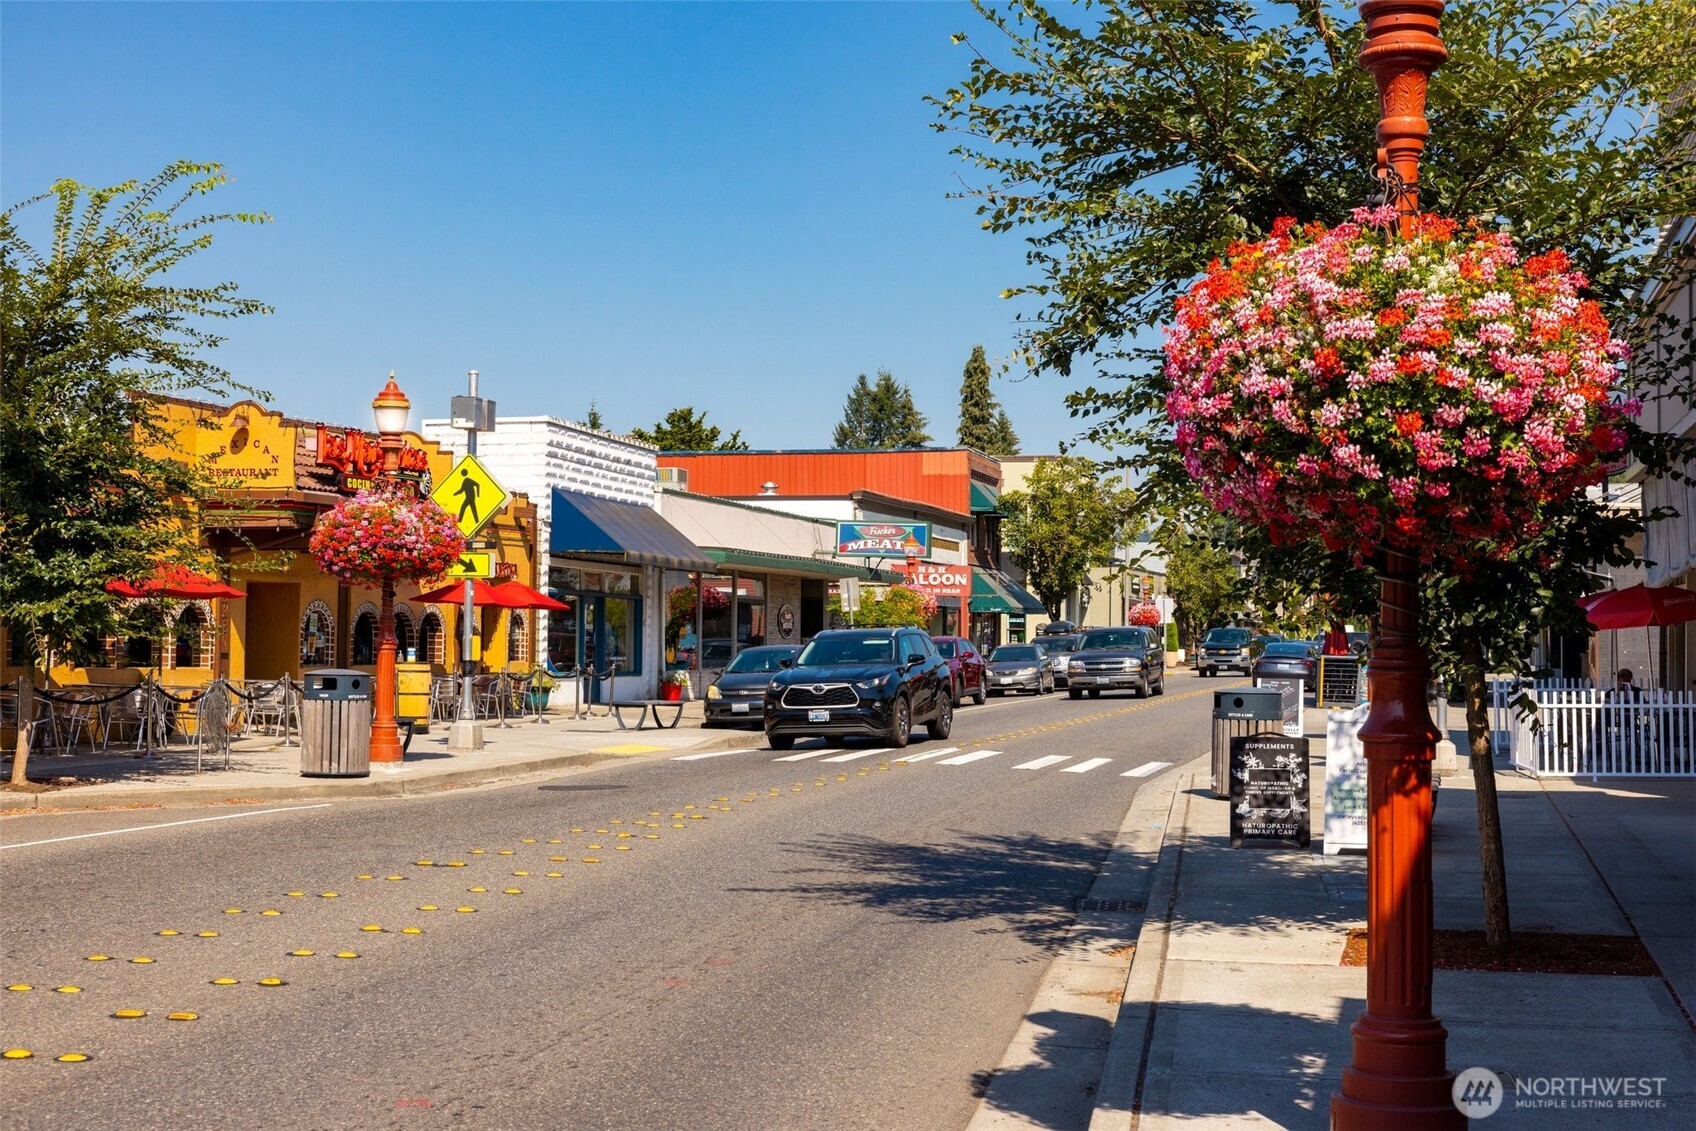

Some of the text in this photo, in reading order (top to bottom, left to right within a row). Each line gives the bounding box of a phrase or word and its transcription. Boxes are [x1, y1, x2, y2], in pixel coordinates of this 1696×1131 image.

[208, 437, 280, 465] MEXICAN
[207, 468, 280, 478] RESTAURANT
[846, 539, 906, 551] MEAT
[918, 566, 946, 574] H & H
[911, 573, 967, 586] ALOON
